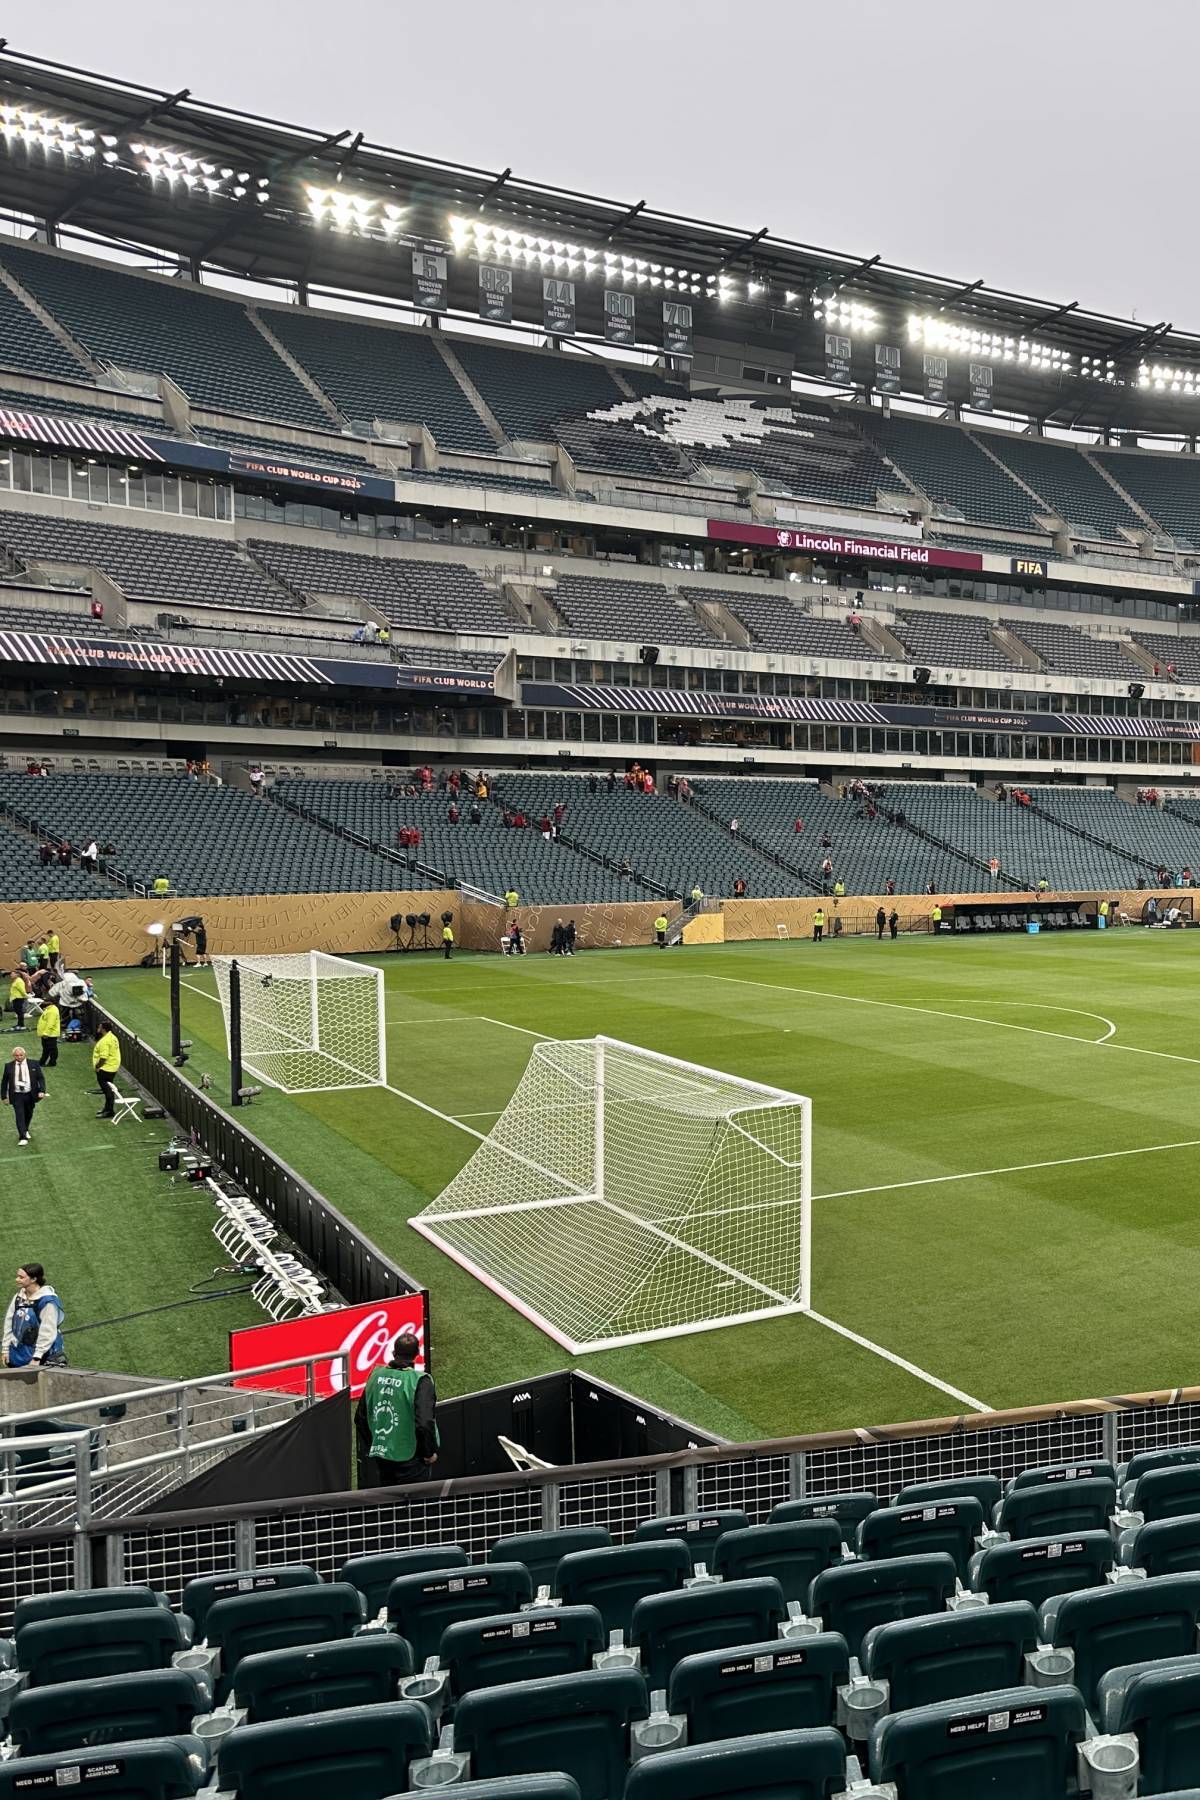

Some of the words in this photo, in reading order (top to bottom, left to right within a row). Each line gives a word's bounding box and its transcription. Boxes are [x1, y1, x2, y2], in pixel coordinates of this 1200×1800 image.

[422, 256, 438, 280] 5
[482, 267, 510, 294] 92
[546, 280, 571, 306] 44
[606, 292, 634, 318] 60
[665, 304, 690, 328] 70
[246, 462, 265, 472] FIFA
[266, 466, 289, 476] CLUB
[290, 469, 321, 481] WORLD
[322, 476, 339, 485] CUP
[795, 534, 842, 552] Lincoln
[844, 540, 898, 560] Financial
[901, 548, 929, 563] Field
[1016, 560, 1042, 575] FIFA
[75, 648, 103, 659] CLUB
[108, 651, 146, 662] WORLD
[434, 677, 455, 686] CLUB
[456, 679, 486, 689] WORLD
[378, 1377, 402, 1388] PHOTO
[967, 1722, 986, 1730] HELP?
[34, 1776, 54, 1784] HELP?
[85, 1769, 120, 1778] ASSISTANCE
